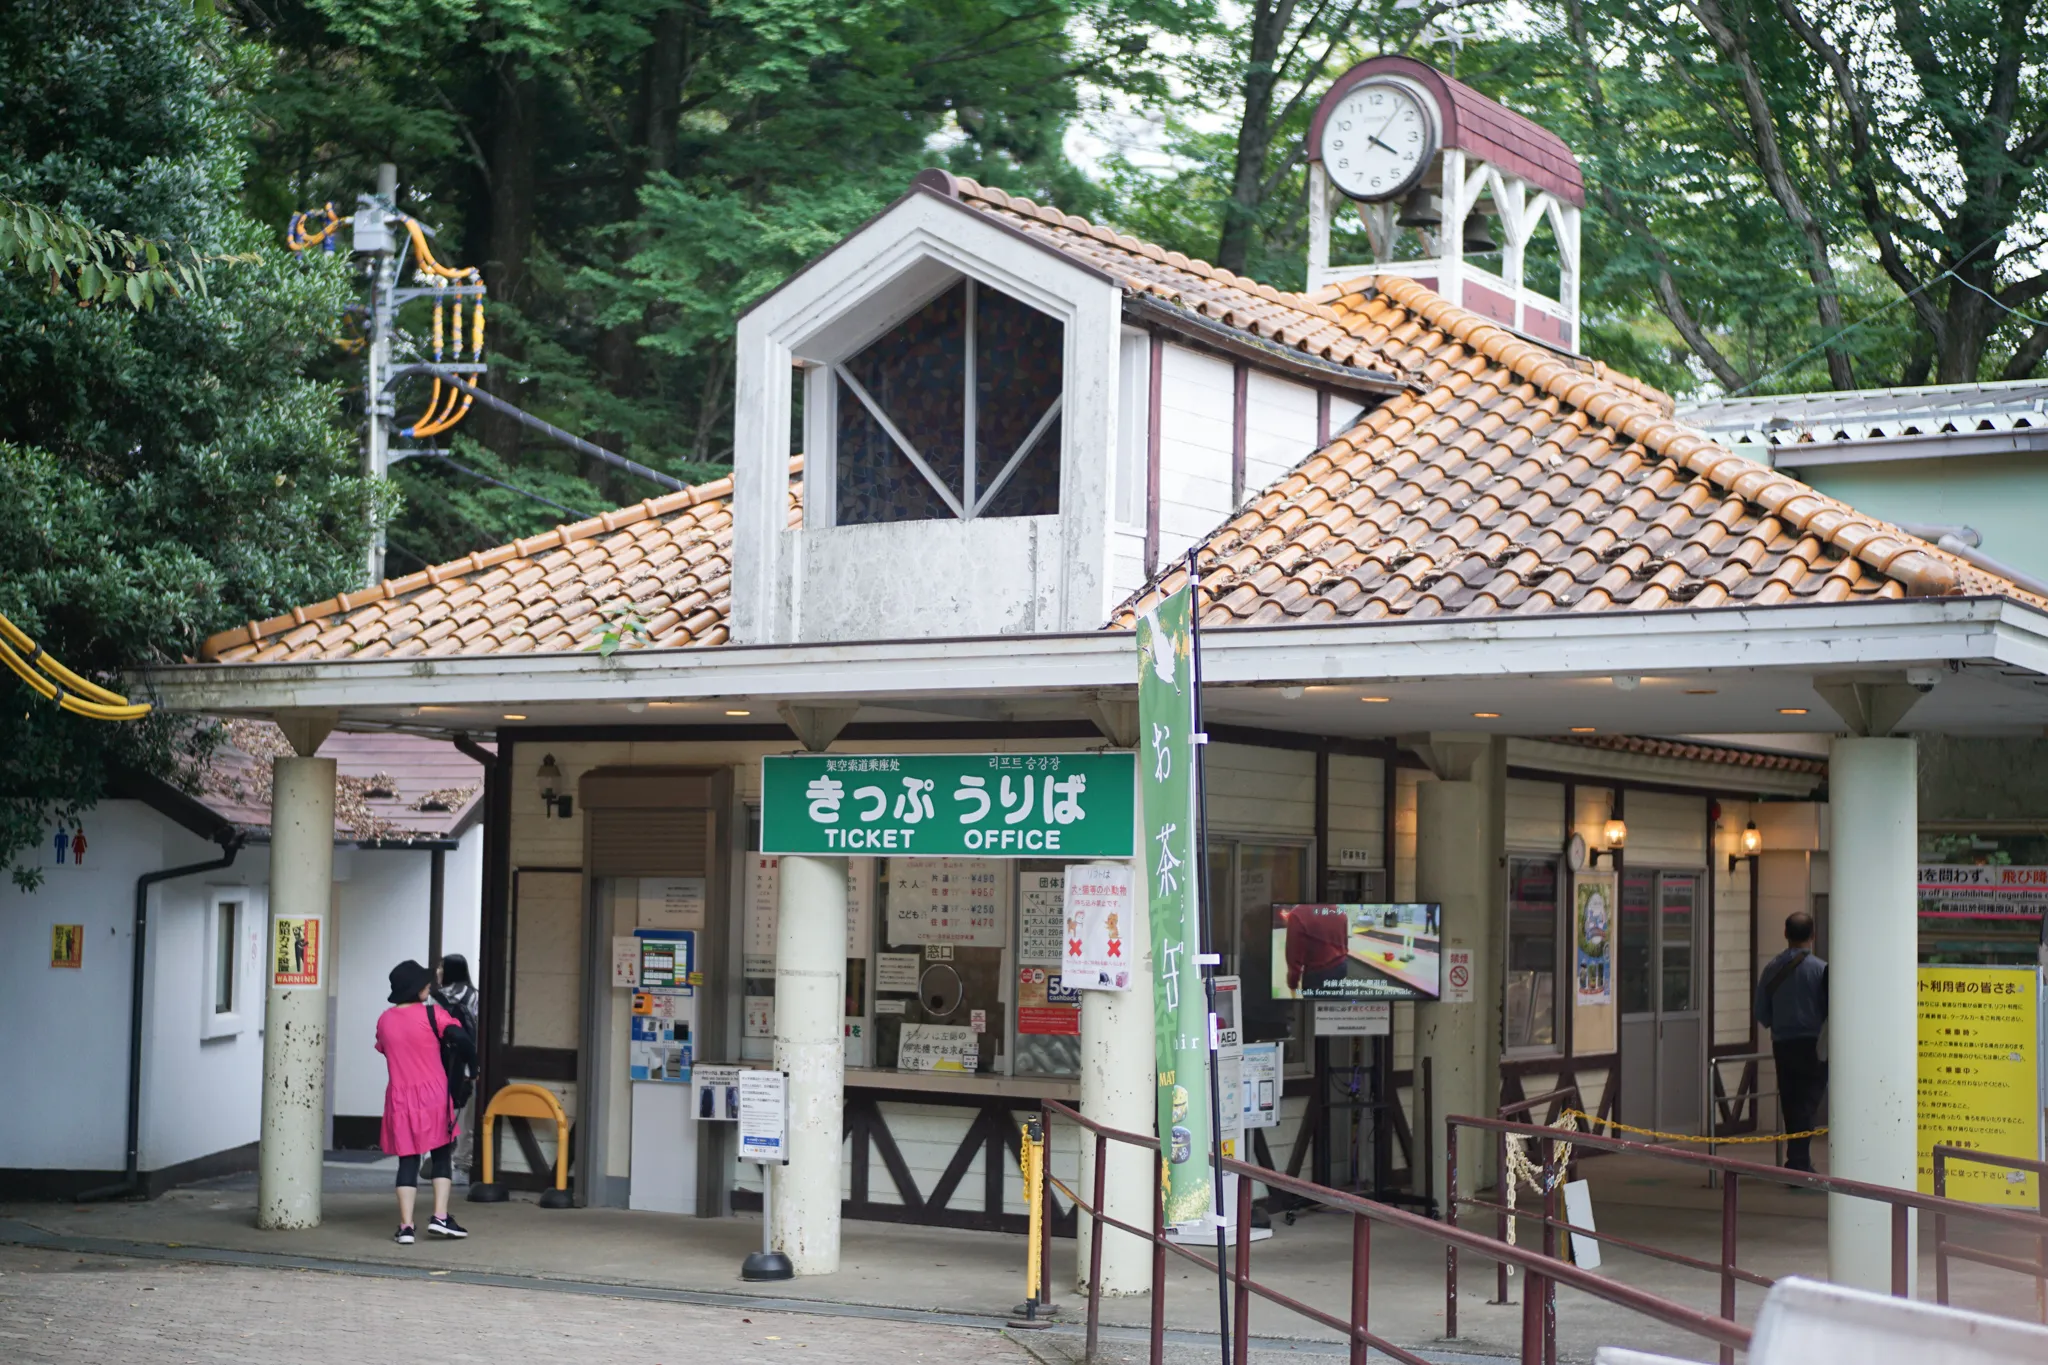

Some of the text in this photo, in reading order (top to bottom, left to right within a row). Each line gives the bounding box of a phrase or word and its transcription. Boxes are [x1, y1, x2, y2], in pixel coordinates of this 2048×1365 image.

[1369, 94, 1383, 106] 12
[1350, 103, 1363, 113] 11
[1404, 111, 1414, 121] 2
[1337, 121, 1352, 131] 10
[1408, 132, 1418, 142] 3
[1333, 140, 1344, 150] 9
[1403, 152, 1414, 162] 4
[1338, 159, 1349, 168] 8
[1354, 172, 1364, 182] 7
[1390, 168, 1400, 179] 5
[1371, 176, 1381, 187] 6
[989, 756, 1061, 771] 리프트 승강장
[805, 773, 1086, 824] きっぷ うりば
[825, 829, 1061, 850] TICKET OFFICE
[932, 874, 949, 882] 片道
[1088, 871, 1110, 879] リフトは
[899, 880, 919, 889] 大人
[932, 888, 995, 896] 往復 ¥950
[1929, 889, 1940, 898] off
[1942, 890, 1949, 898] is
[1951, 890, 1994, 900] prohibited
[1998, 891, 2042, 900] regardless
[898, 910, 919, 919] こども
[931, 905, 994, 914] 片道 ¥250
[931, 919, 994, 927] 往復 ¥470
[927, 945, 952, 959] 窓口
[1450, 953, 1469, 964] 禁煙
[1296, 988, 1314, 996] Walk
[1315, 988, 1342, 996] forward
[1346, 988, 1358, 996] and
[1360, 988, 1373, 996] exit
[1918, 980, 2016, 994] ト利用者の皆さま
[1221, 1031, 1237, 1043] AED
[1159, 1070, 1176, 1087] MAT
